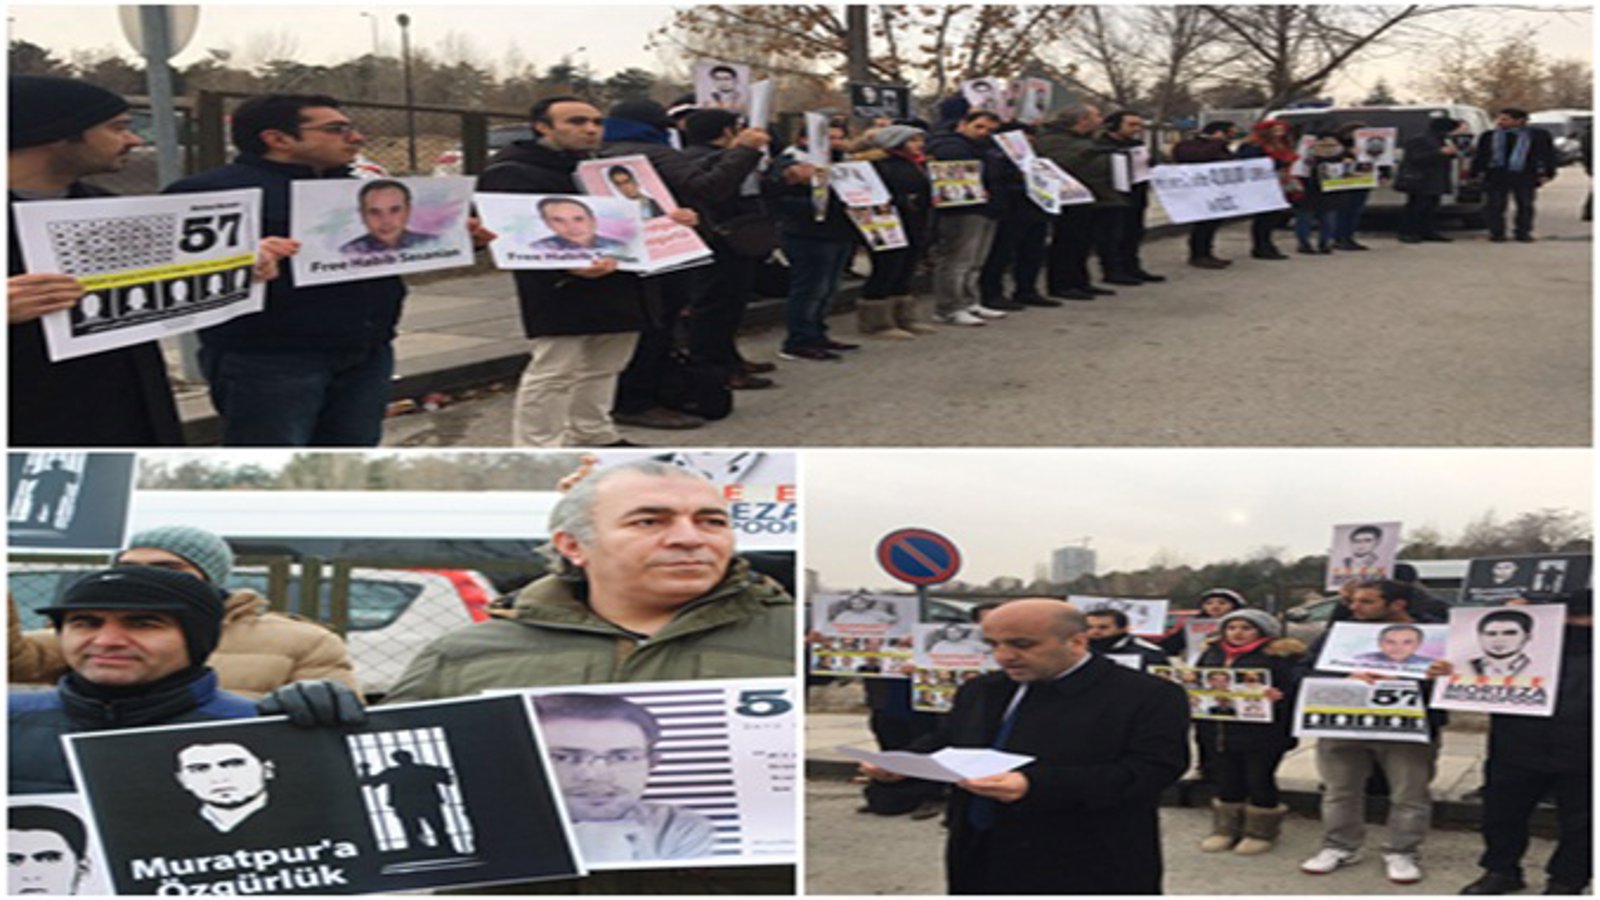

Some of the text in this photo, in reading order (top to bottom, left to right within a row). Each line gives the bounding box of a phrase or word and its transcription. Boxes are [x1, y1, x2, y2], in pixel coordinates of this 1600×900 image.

[178, 212, 242, 254] 57
[310, 261, 347, 272] Free
[1371, 689, 1419, 707] 57
[131, 839, 358, 881] Muratpur'a
